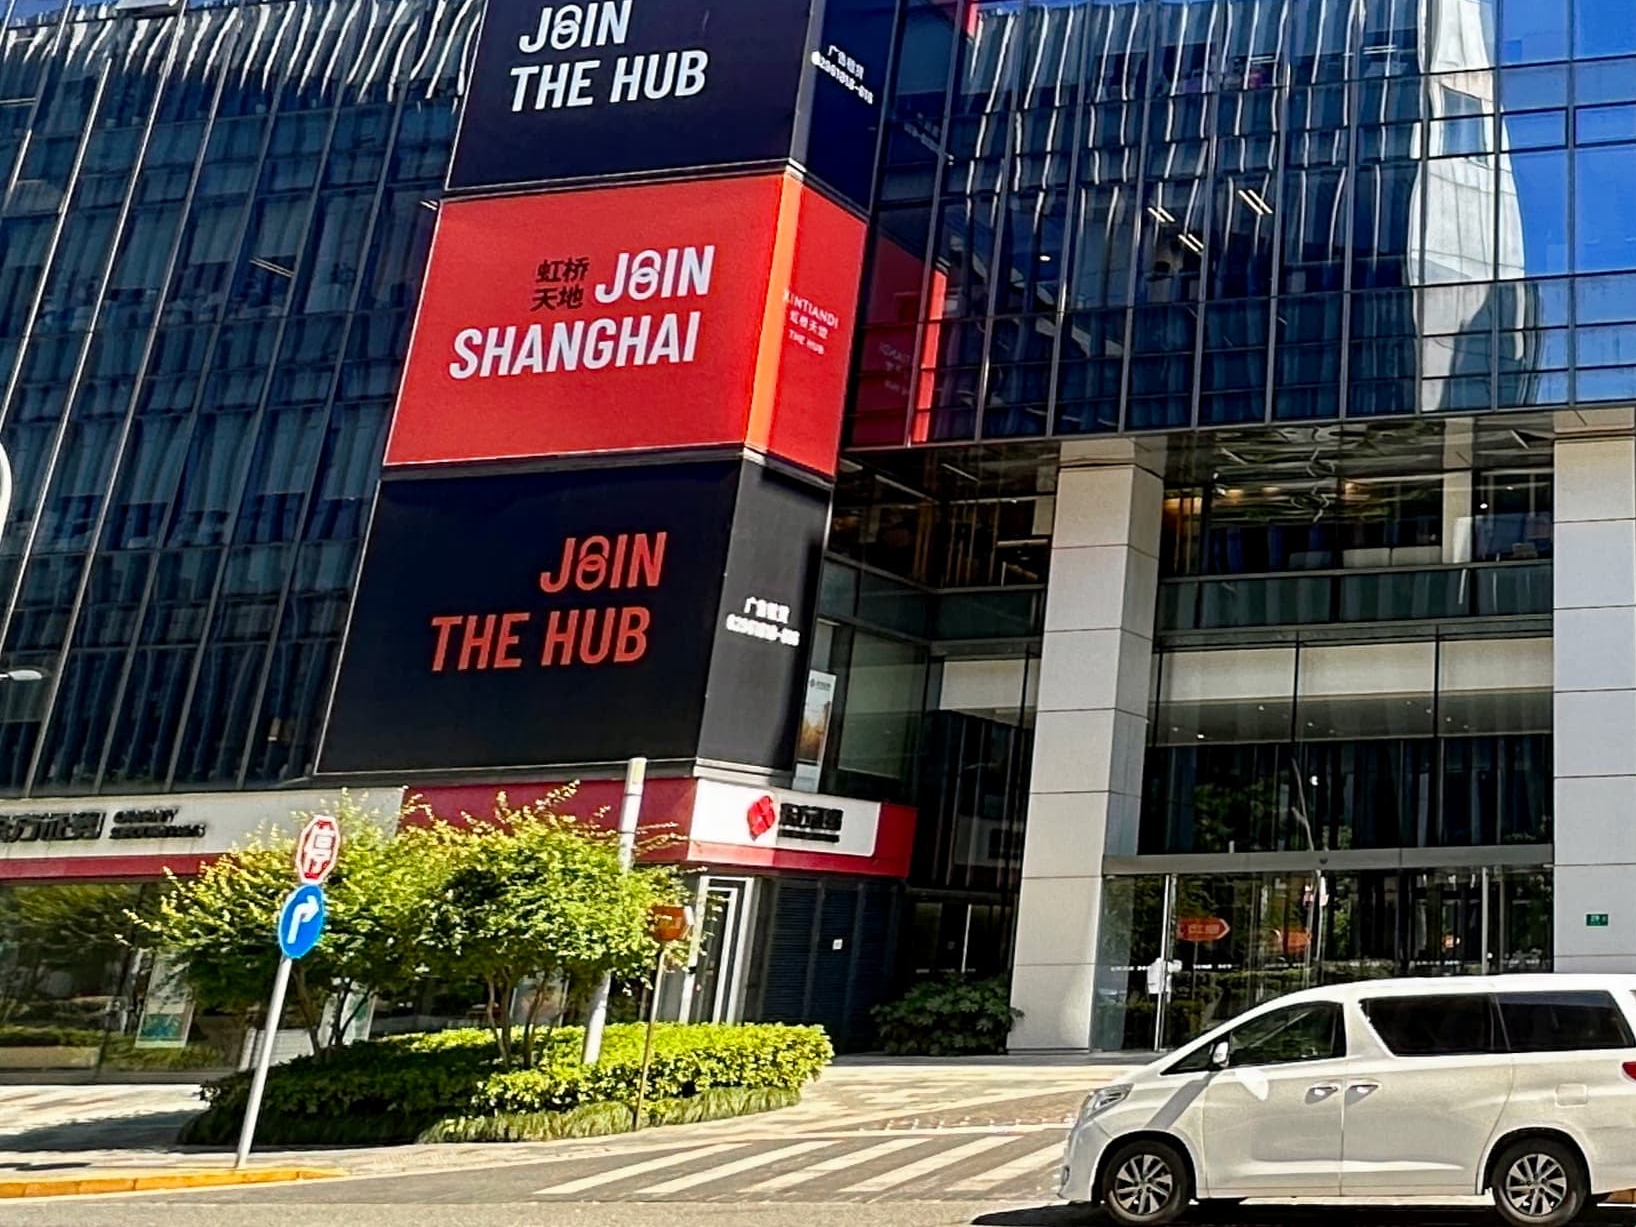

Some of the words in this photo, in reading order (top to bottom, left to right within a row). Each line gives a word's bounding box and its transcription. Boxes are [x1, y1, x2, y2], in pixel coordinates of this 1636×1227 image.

[518, 0, 633, 54] JOIN
[510, 62, 599, 112] THE
[610, 50, 709, 103] HUB
[530, 286, 584, 312] 天地
[535, 257, 589, 284] 虹桥
[595, 245, 715, 304] JOIN
[448, 311, 700, 380] SHANGHAI
[540, 532, 667, 593] JOIN
[431, 613, 530, 672] THE
[541, 606, 650, 665] HUB
[303, 820, 336, 876] 停
